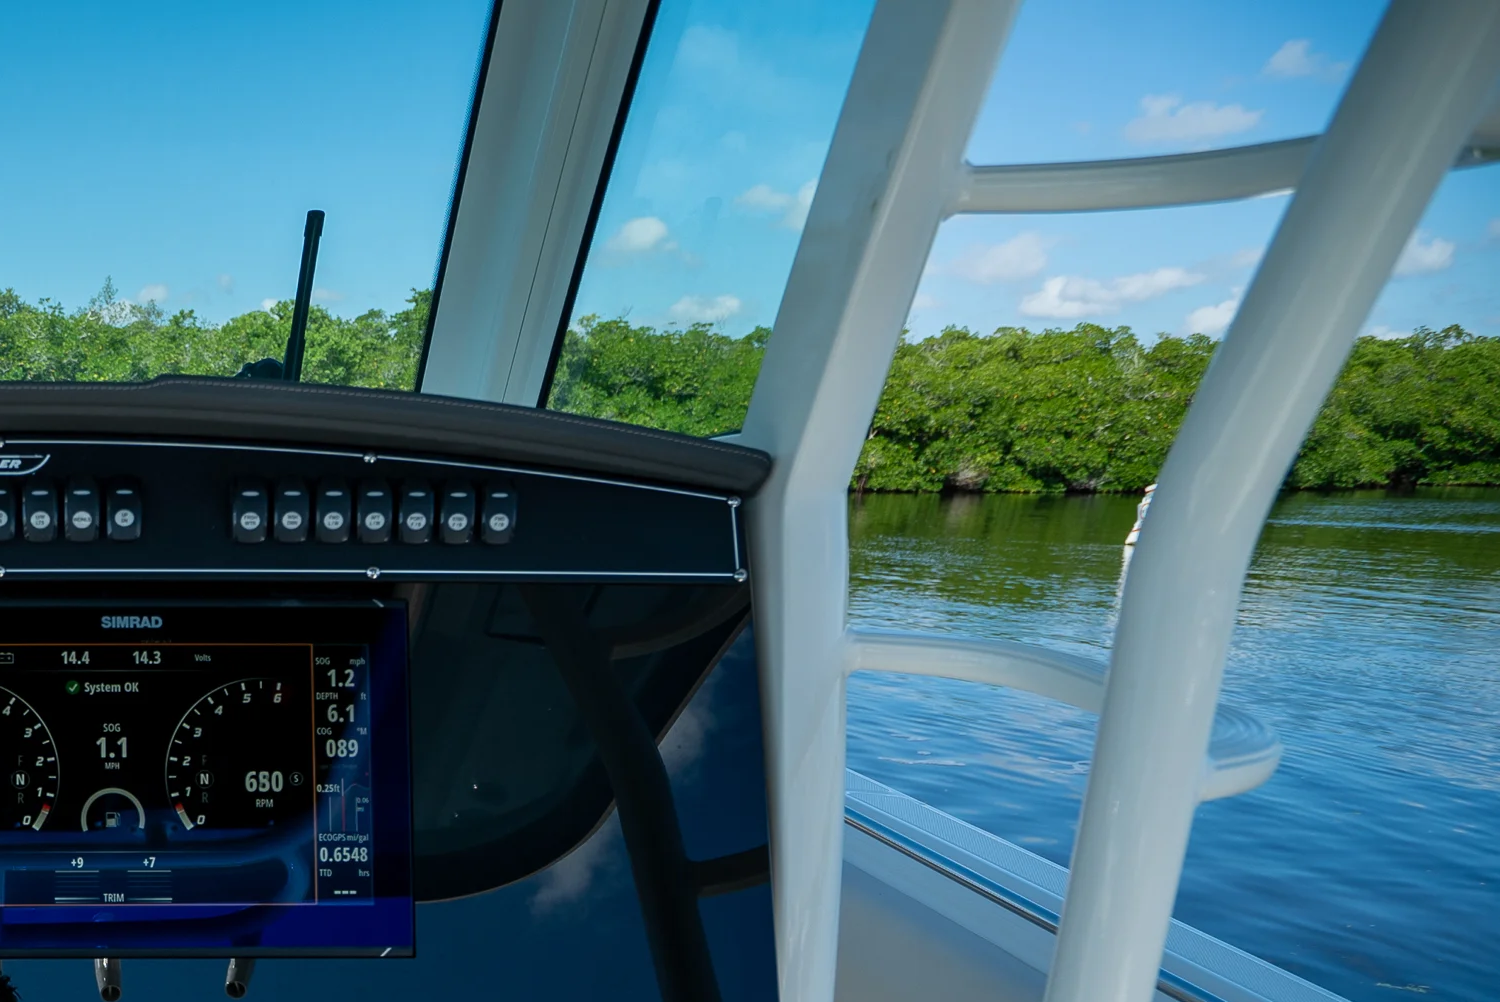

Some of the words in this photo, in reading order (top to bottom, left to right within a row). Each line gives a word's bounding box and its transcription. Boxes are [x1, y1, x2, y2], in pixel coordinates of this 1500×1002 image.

[100, 615, 163, 629] SIMRAD
[60, 651, 90, 665] 14.4
[132, 651, 161, 665] 14.3
[194, 653, 211, 662] Volts
[315, 657, 330, 665] SOG
[349, 657, 366, 667] mph
[327, 668, 355, 688] 1.2
[83, 682, 121, 694] System
[123, 682, 139, 693] OK
[242, 693, 251, 704] 5
[273, 693, 282, 704] 6
[315, 692, 338, 700] DEPTH
[360, 692, 366, 700] ft
[2, 705, 11, 716] 4
[214, 705, 223, 716] 4
[327, 703, 354, 723] 6.1
[24, 727, 33, 738] 3
[103, 723, 121, 733] SOG
[193, 727, 202, 738] 3
[316, 727, 332, 735] COG
[95, 736, 128, 759] 1.1
[325, 738, 358, 758] 089
[35, 756, 44, 767] 2
[104, 762, 120, 770] MPH
[182, 756, 191, 766] 2
[15, 773, 25, 786] N
[199, 773, 209, 785] N
[36, 787, 43, 797] 1
[185, 786, 191, 797] 1
[255, 798, 274, 808] RPM
[22, 815, 31, 826] 0
[196, 814, 205, 825] 0
[319, 834, 346, 842] ECOGPS
[346, 834, 369, 843] mi/gal
[319, 847, 368, 863] 0.6548
[70, 857, 84, 869] +9
[142, 857, 156, 869] +7
[319, 869, 332, 877] TTD
[358, 869, 370, 877] hrs
[103, 893, 125, 903] TRIM
